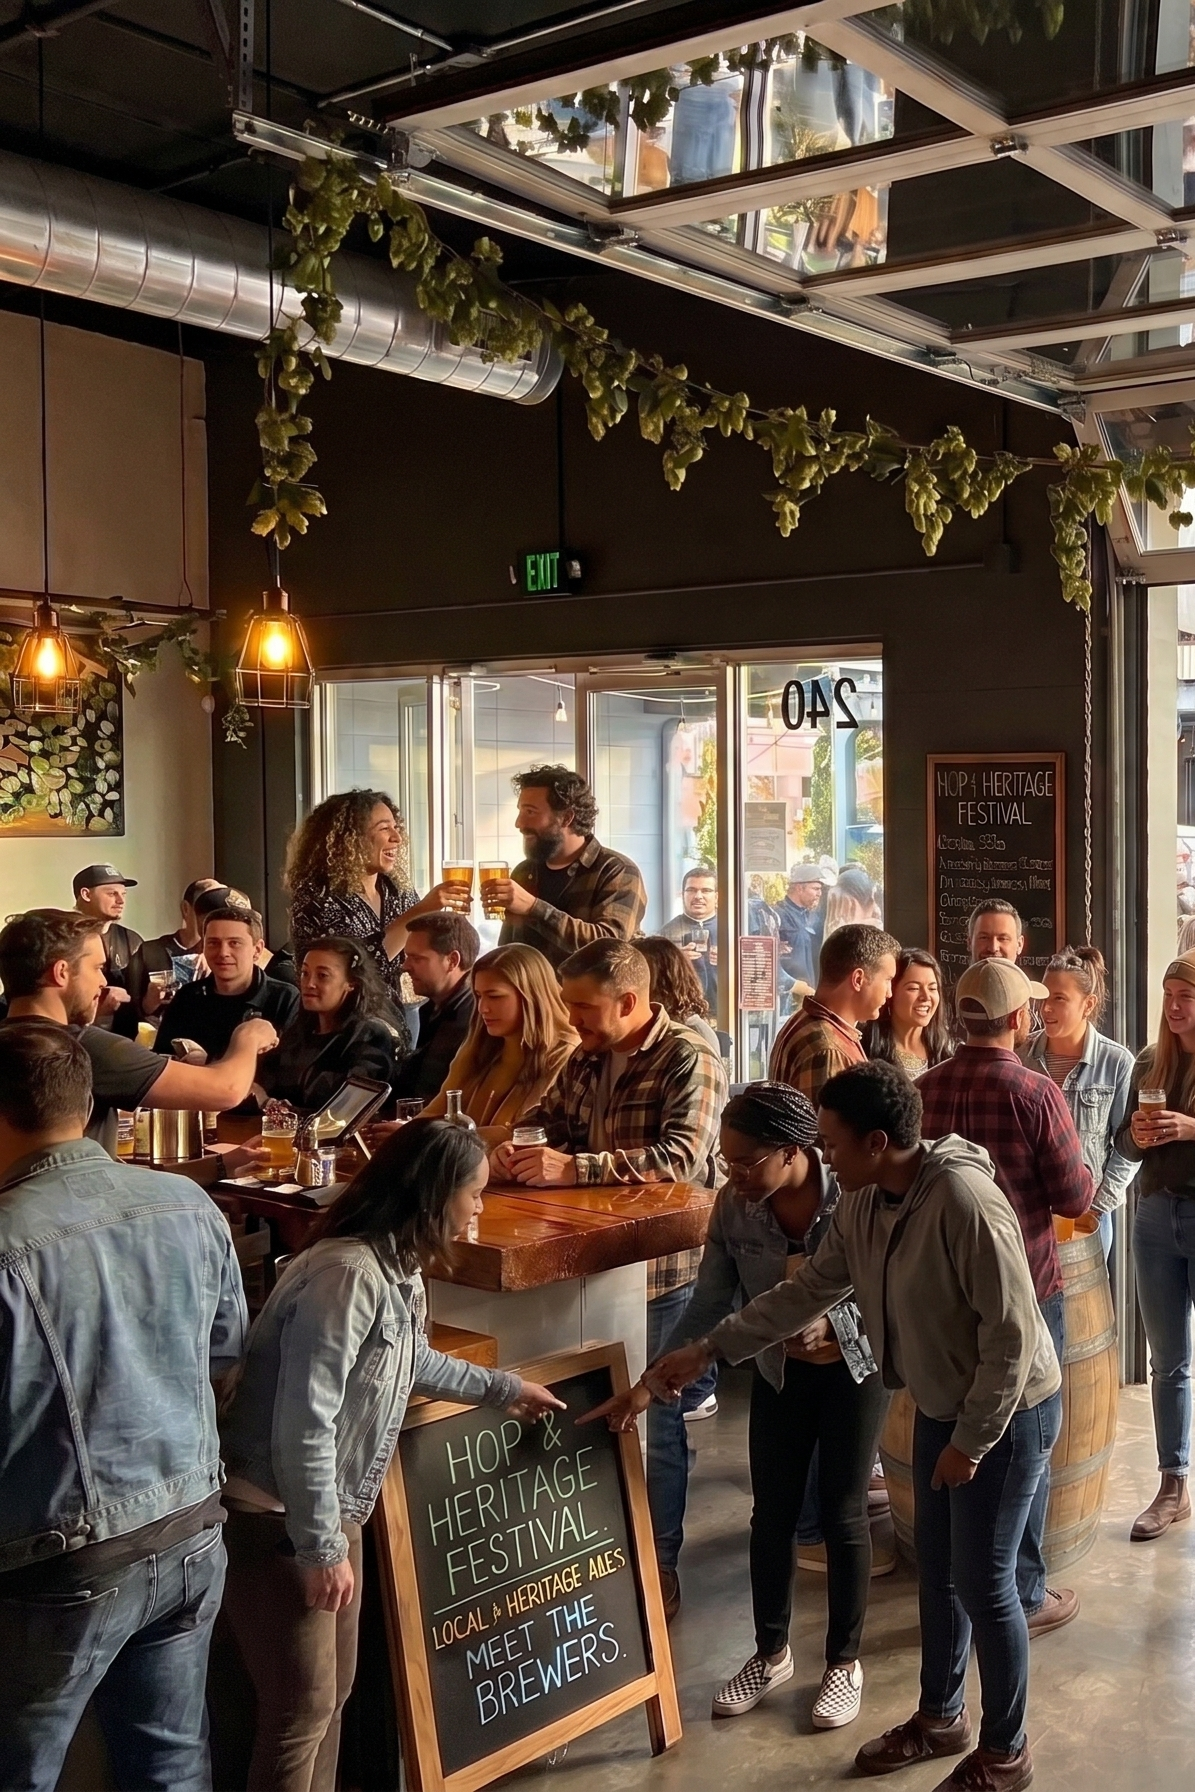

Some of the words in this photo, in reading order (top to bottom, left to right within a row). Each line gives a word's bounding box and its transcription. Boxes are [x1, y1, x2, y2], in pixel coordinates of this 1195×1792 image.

[526, 552, 560, 591] EXIT
[937, 771, 968, 797] HOP
[982, 771, 1054, 797] HERITAGE
[958, 801, 1032, 826] FESTIVAL
[446, 1419, 522, 1485] HOP
[543, 1410, 562, 1451] &
[428, 1446, 598, 1546] HERITAGE
[432, 1607, 489, 1650] LOCAL
[506, 1563, 583, 1618] HERITAGE
[466, 1620, 534, 1680] MEET
[545, 1594, 598, 1638] THE
[476, 1621, 627, 1726] BREWERS.
